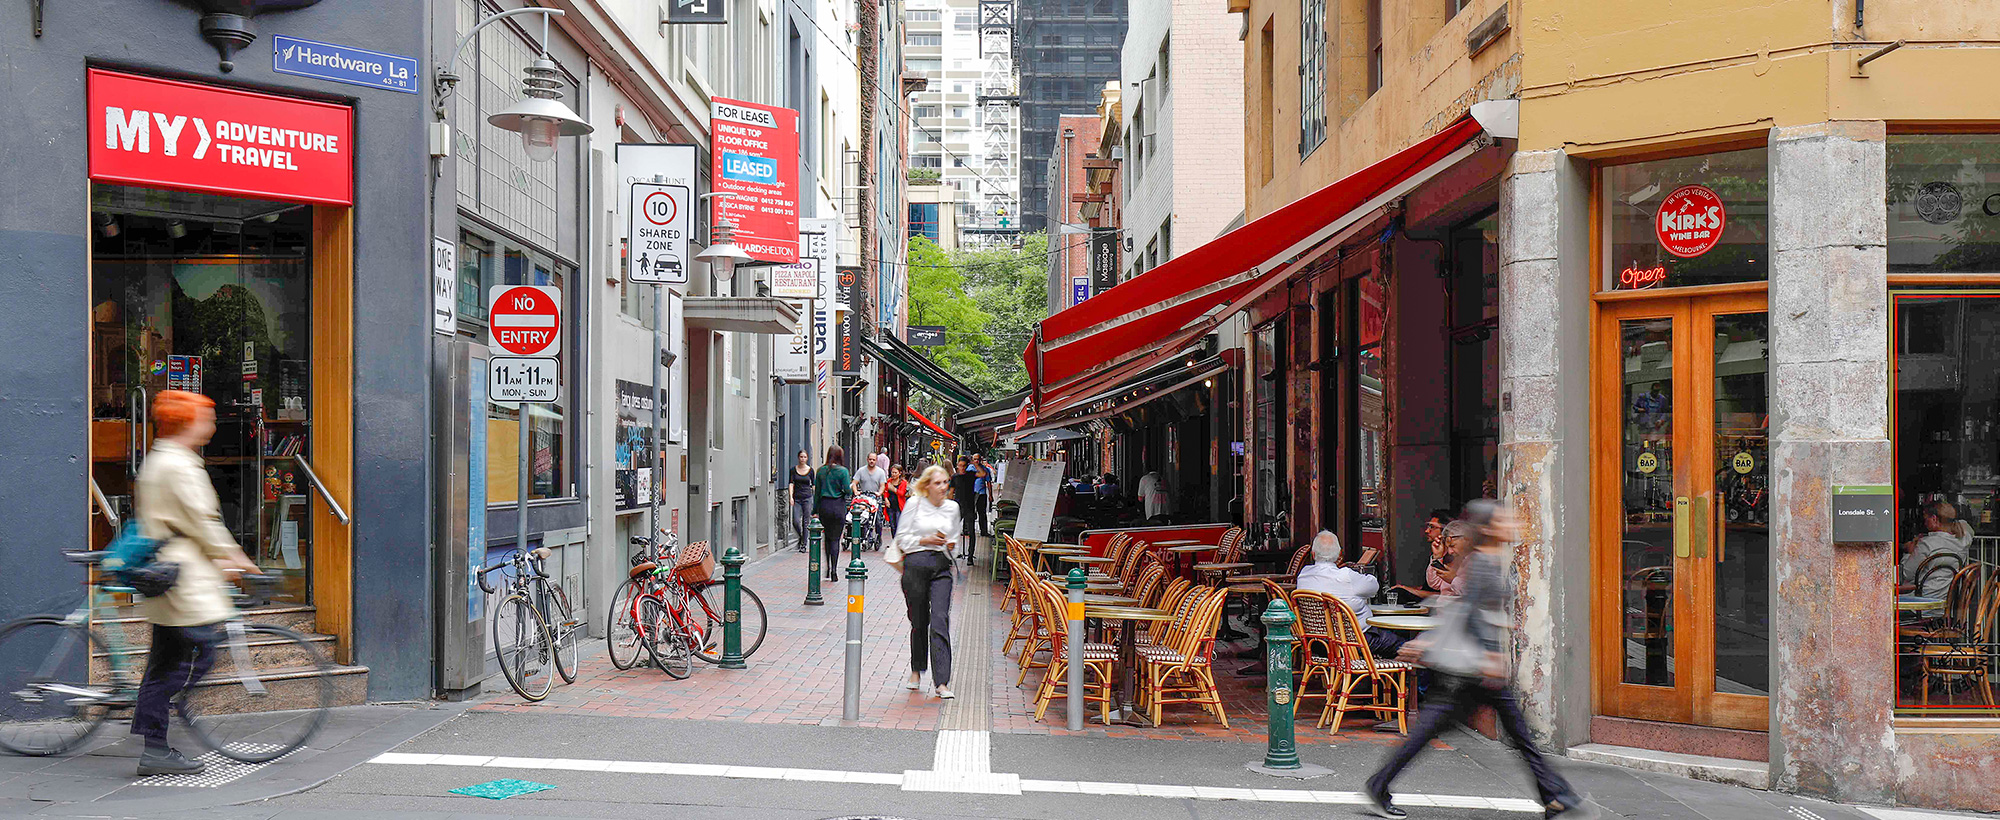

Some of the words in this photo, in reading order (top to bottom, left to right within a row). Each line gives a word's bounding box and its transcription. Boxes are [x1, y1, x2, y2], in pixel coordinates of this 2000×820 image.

[297, 46, 383, 75] Hardware
[389, 61, 408, 79] La
[382, 77, 392, 85] 43
[718, 106, 738, 119] FOR
[741, 110, 769, 124] LEASE
[105, 106, 188, 157] MY
[215, 120, 338, 154] ADVENTURE
[717, 123, 746, 136] UNIQUE
[747, 128, 762, 138] TOP
[717, 134, 742, 146] FLOOR
[743, 139, 768, 150] OFFICE
[216, 143, 298, 171] TRAVEL
[726, 158, 773, 178] LEASED
[662, 177, 686, 185] HUNT
[722, 181, 745, 191] Outdoor
[746, 185, 768, 195] decking
[736, 194, 758, 203] WAGNER
[761, 197, 774, 205] 0412
[1668, 197, 1675, 205] IN
[1676, 189, 1691, 199] VINO
[1691, 189, 1713, 201] VERITAS
[652, 201, 668, 216] 10
[718, 201, 738, 209] JESICA
[761, 206, 774, 214] 0413
[1661, 206, 1720, 232] KIRK'S
[639, 228, 681, 239] SHARED
[1670, 231, 1691, 241] WINE
[1693, 230, 1711, 239] BAR
[646, 240, 673, 251] ZONE
[1674, 242, 1706, 254] MELBOURNE
[436, 247, 452, 271] ONE
[1101, 243, 1109, 282] Massage
[774, 270, 792, 278] PIZZA
[793, 270, 816, 279] NAPOLI
[1621, 266, 1666, 289] Open
[435, 275, 454, 299] WAY
[774, 278, 816, 288] RESTAURANT
[514, 297, 535, 311] NO
[500, 330, 550, 344] ENTRY
[502, 389, 521, 397] MON
[529, 389, 547, 397] SUN
[1640, 459, 1655, 467] BAR
[1736, 459, 1751, 467] BAR
